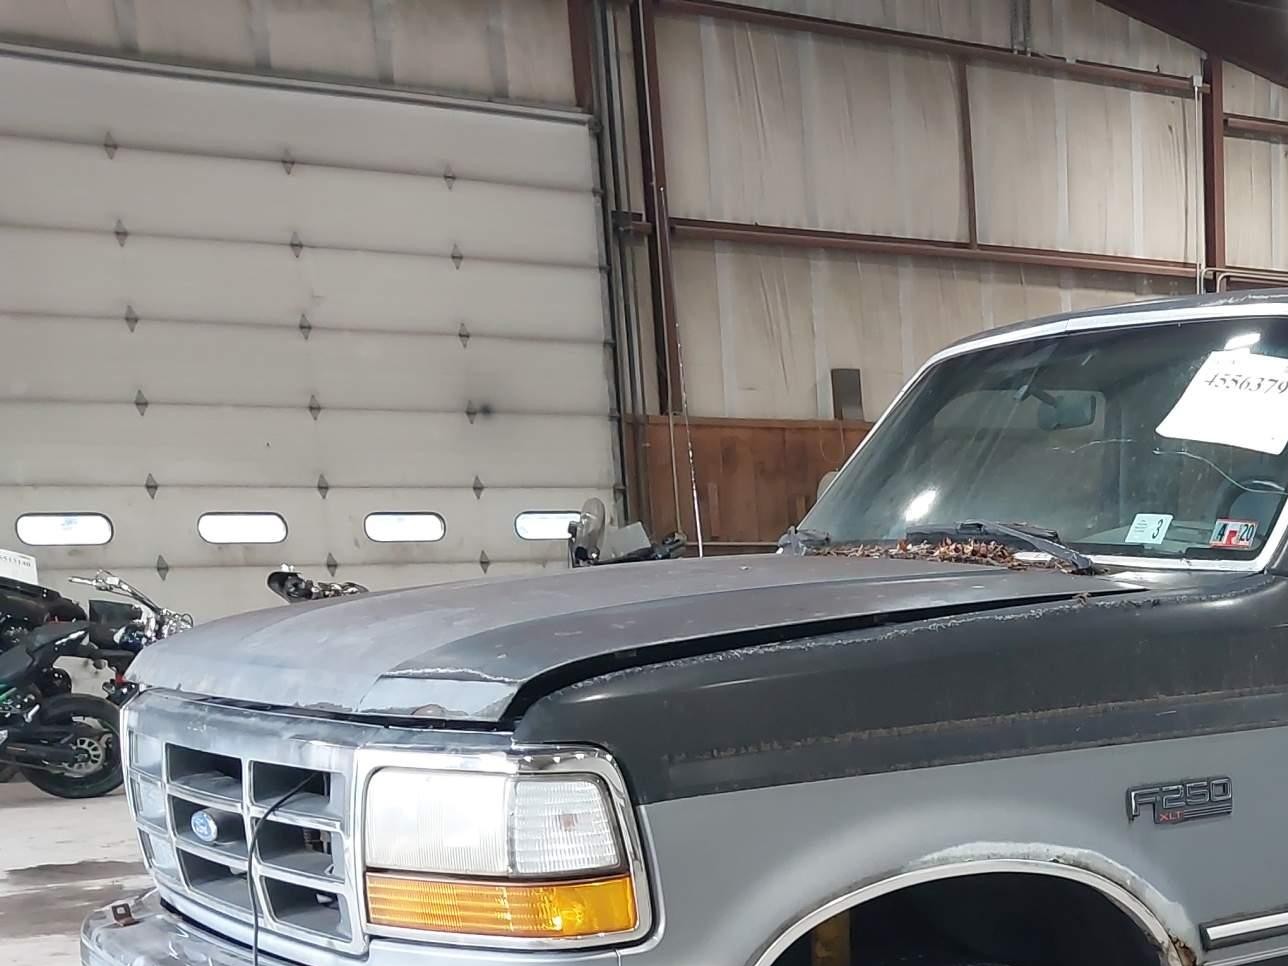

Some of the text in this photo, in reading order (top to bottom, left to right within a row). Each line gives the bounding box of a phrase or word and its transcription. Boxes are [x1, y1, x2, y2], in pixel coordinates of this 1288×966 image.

[1152, 519, 1164, 539] 3
[1239, 523, 1255, 541] 20
[1130, 778, 1232, 818] F250
[1160, 811, 1184, 822] XLT
